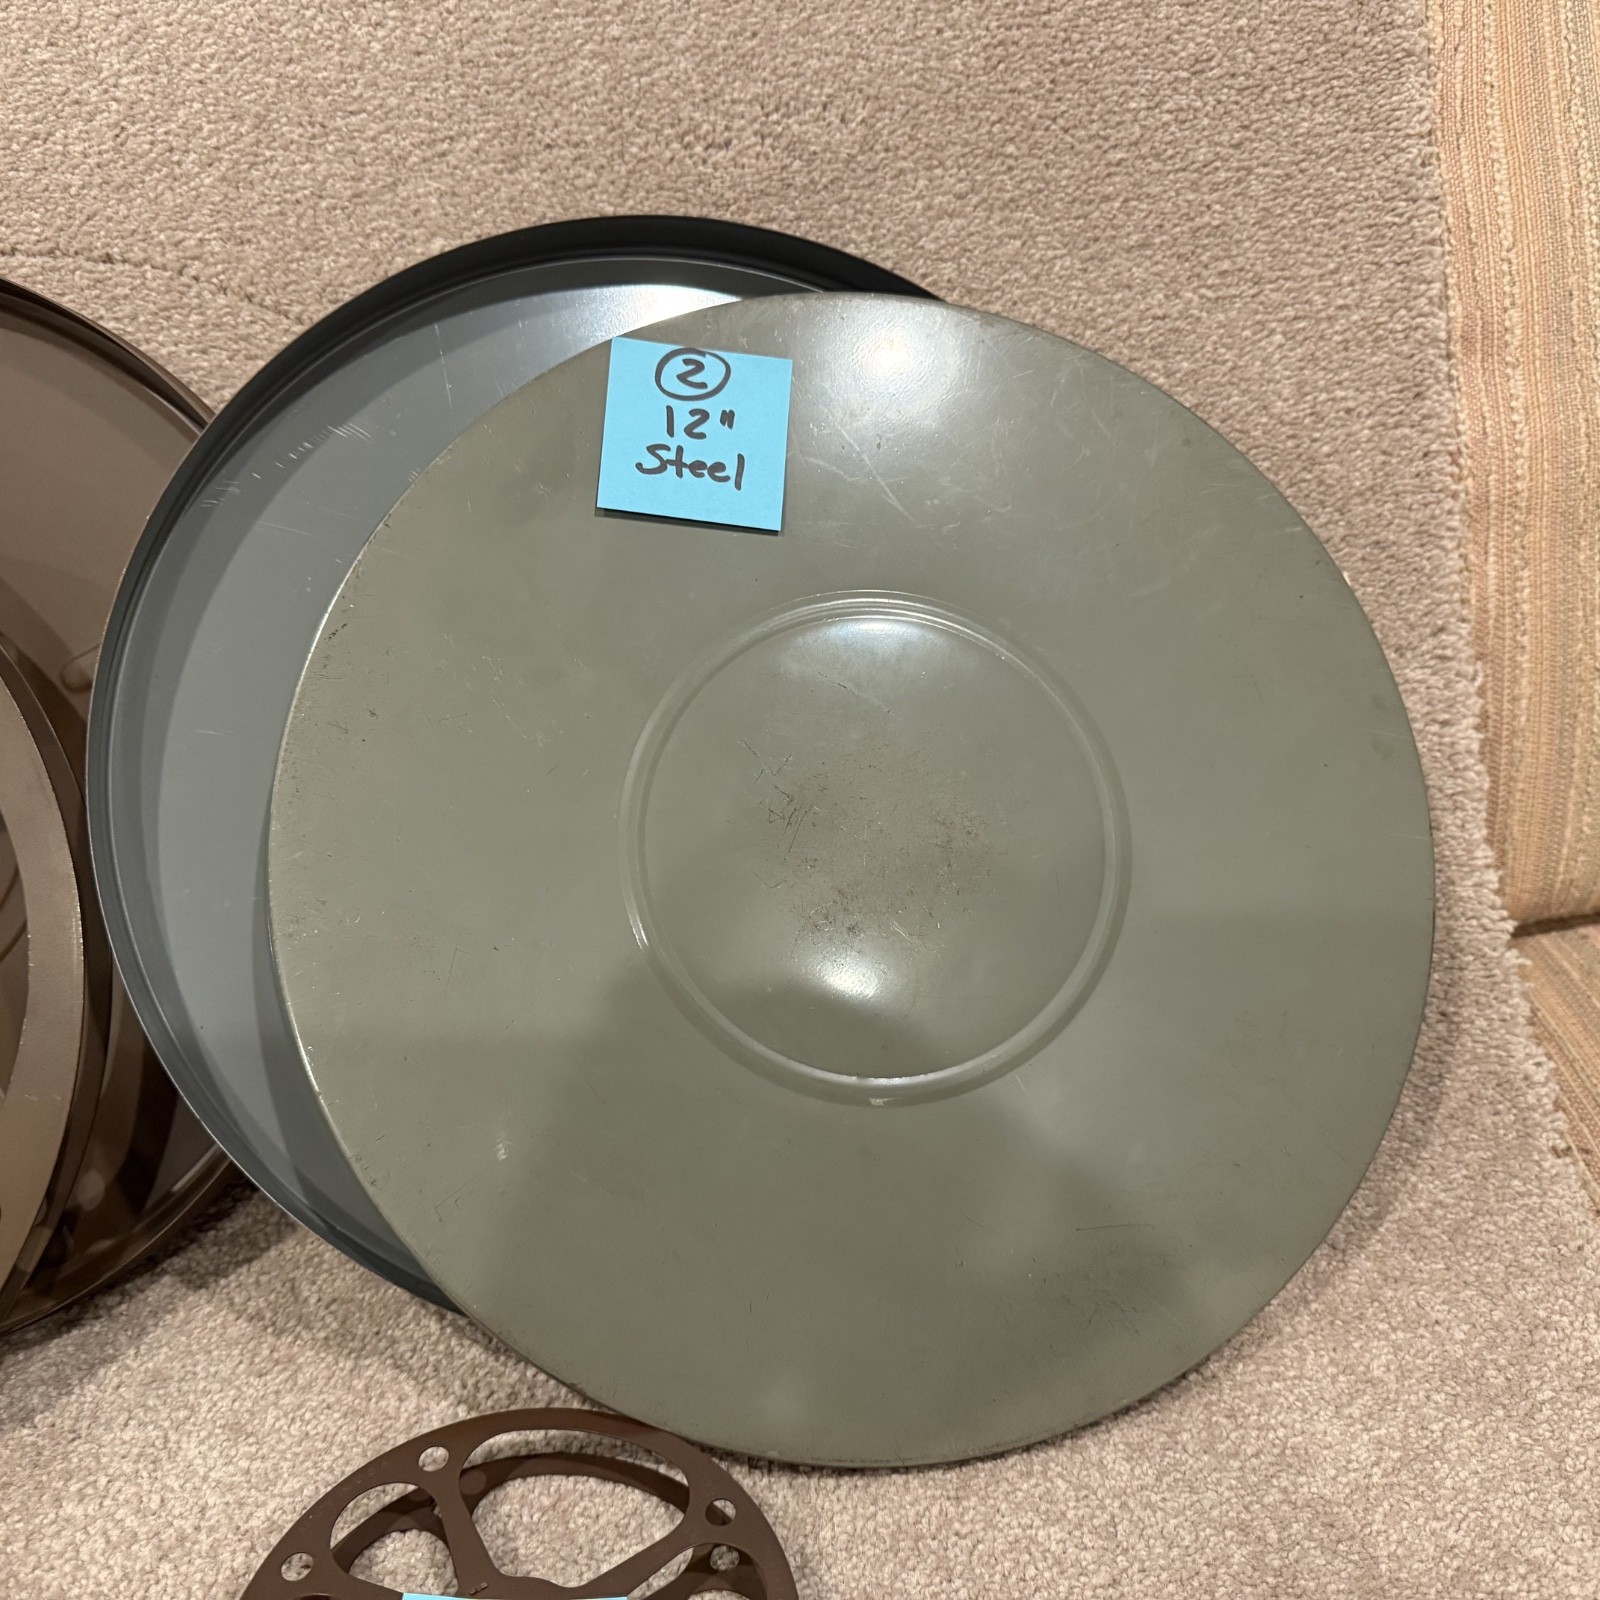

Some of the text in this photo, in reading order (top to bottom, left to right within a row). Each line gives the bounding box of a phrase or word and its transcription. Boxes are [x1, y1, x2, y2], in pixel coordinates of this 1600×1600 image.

[676, 358, 708, 389] 2
[665, 404, 736, 440] 12"
[635, 443, 745, 491] Steel
